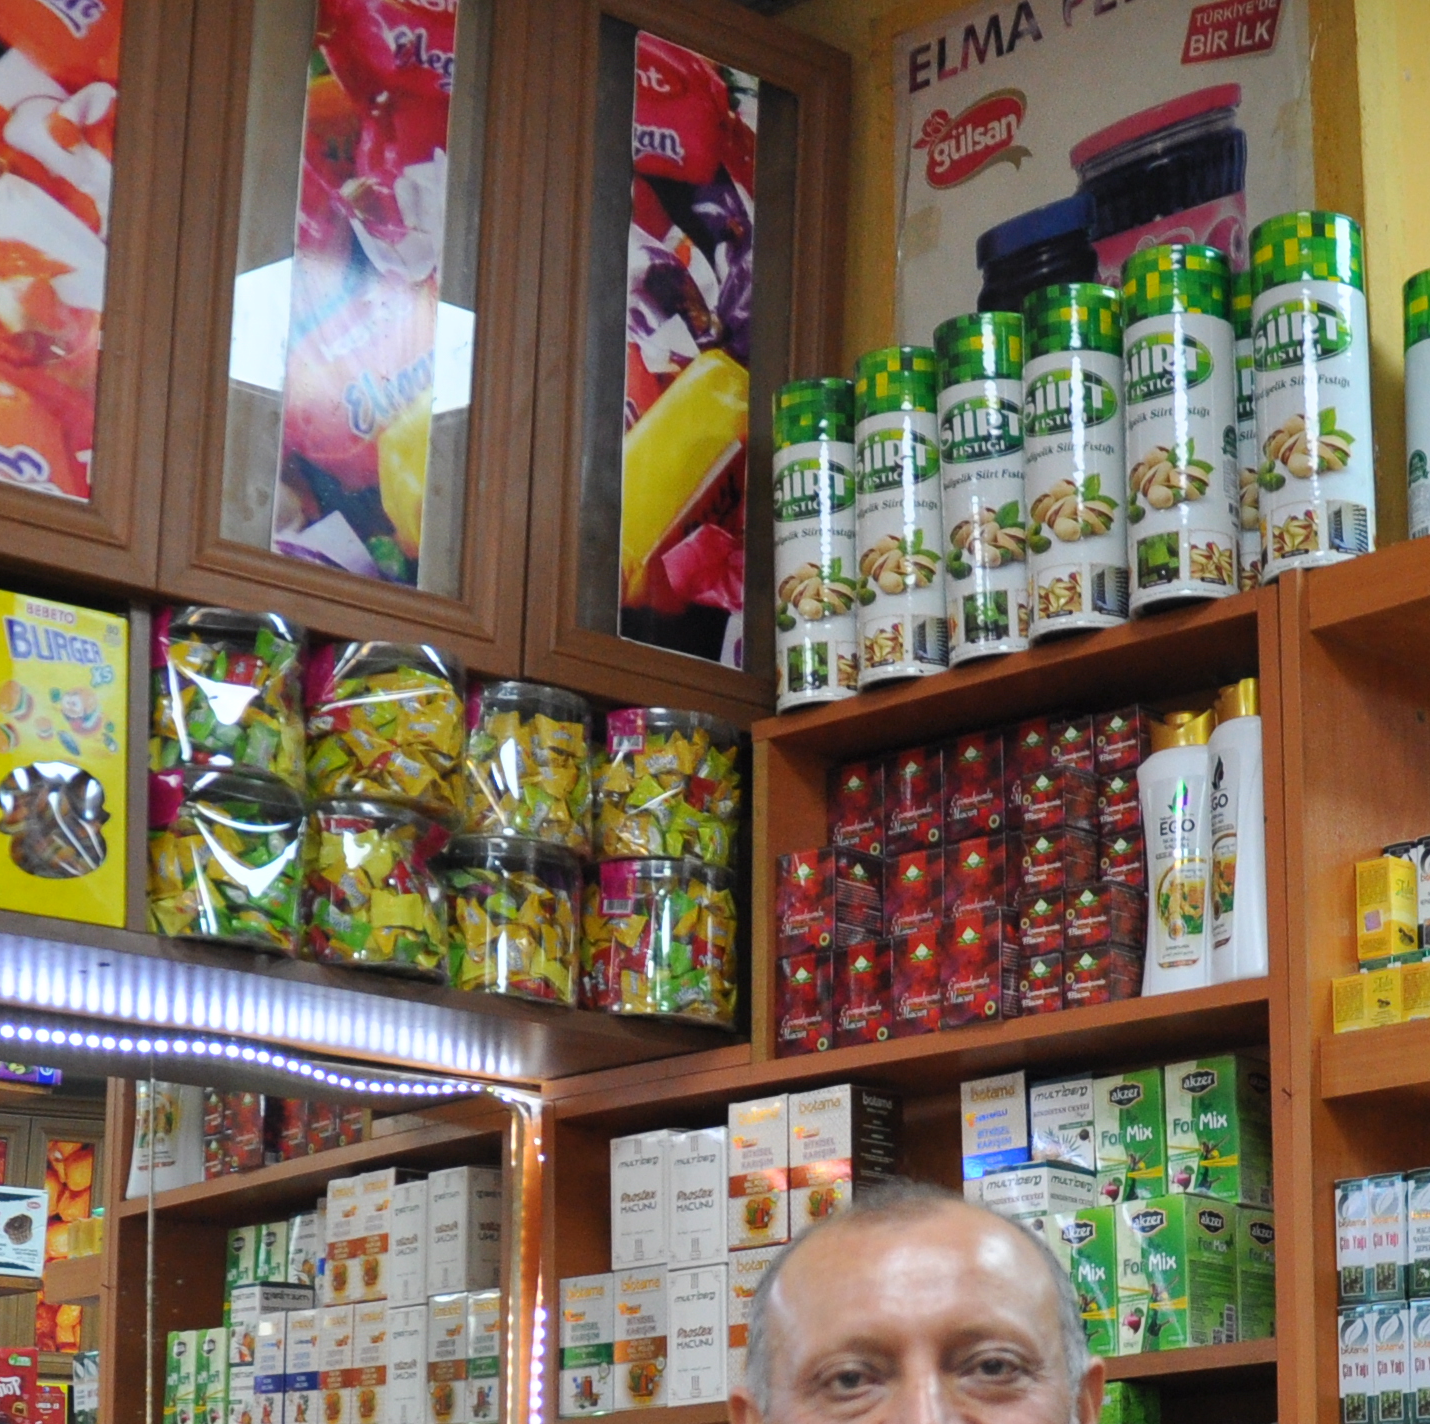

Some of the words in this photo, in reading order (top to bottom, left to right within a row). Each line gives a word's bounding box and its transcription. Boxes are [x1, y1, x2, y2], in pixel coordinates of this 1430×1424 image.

[908, 1, 1043, 94] ELMA
[1188, 31, 1227, 58] BİR
[1236, 18, 1271, 49] İLK
[933, 112, 1019, 173] gülsan
[25, 601, 78, 625] BEBETO
[4, 617, 103, 664] BURGER
[1159, 818, 1195, 837] EGO
[1183, 1073, 1213, 1088] akzer
[1110, 1085, 1139, 1101] akzer
[1173, 1117, 1195, 1135] For
[1199, 1112, 1228, 1131] Mix
[1101, 1130, 1123, 1147] For
[1126, 1124, 1153, 1143] Mix
[620, 1200, 657, 1214] MACUNU
[676, 1199, 714, 1213] MACUNU
[1133, 1212, 1163, 1228] akzer
[1201, 1212, 1223, 1226] akzer
[1078, 1263, 1106, 1283] Mix
[1123, 1258, 1144, 1275] For
[1148, 1253, 1177, 1272] Mix
[676, 1338, 714, 1350] MACUNU
